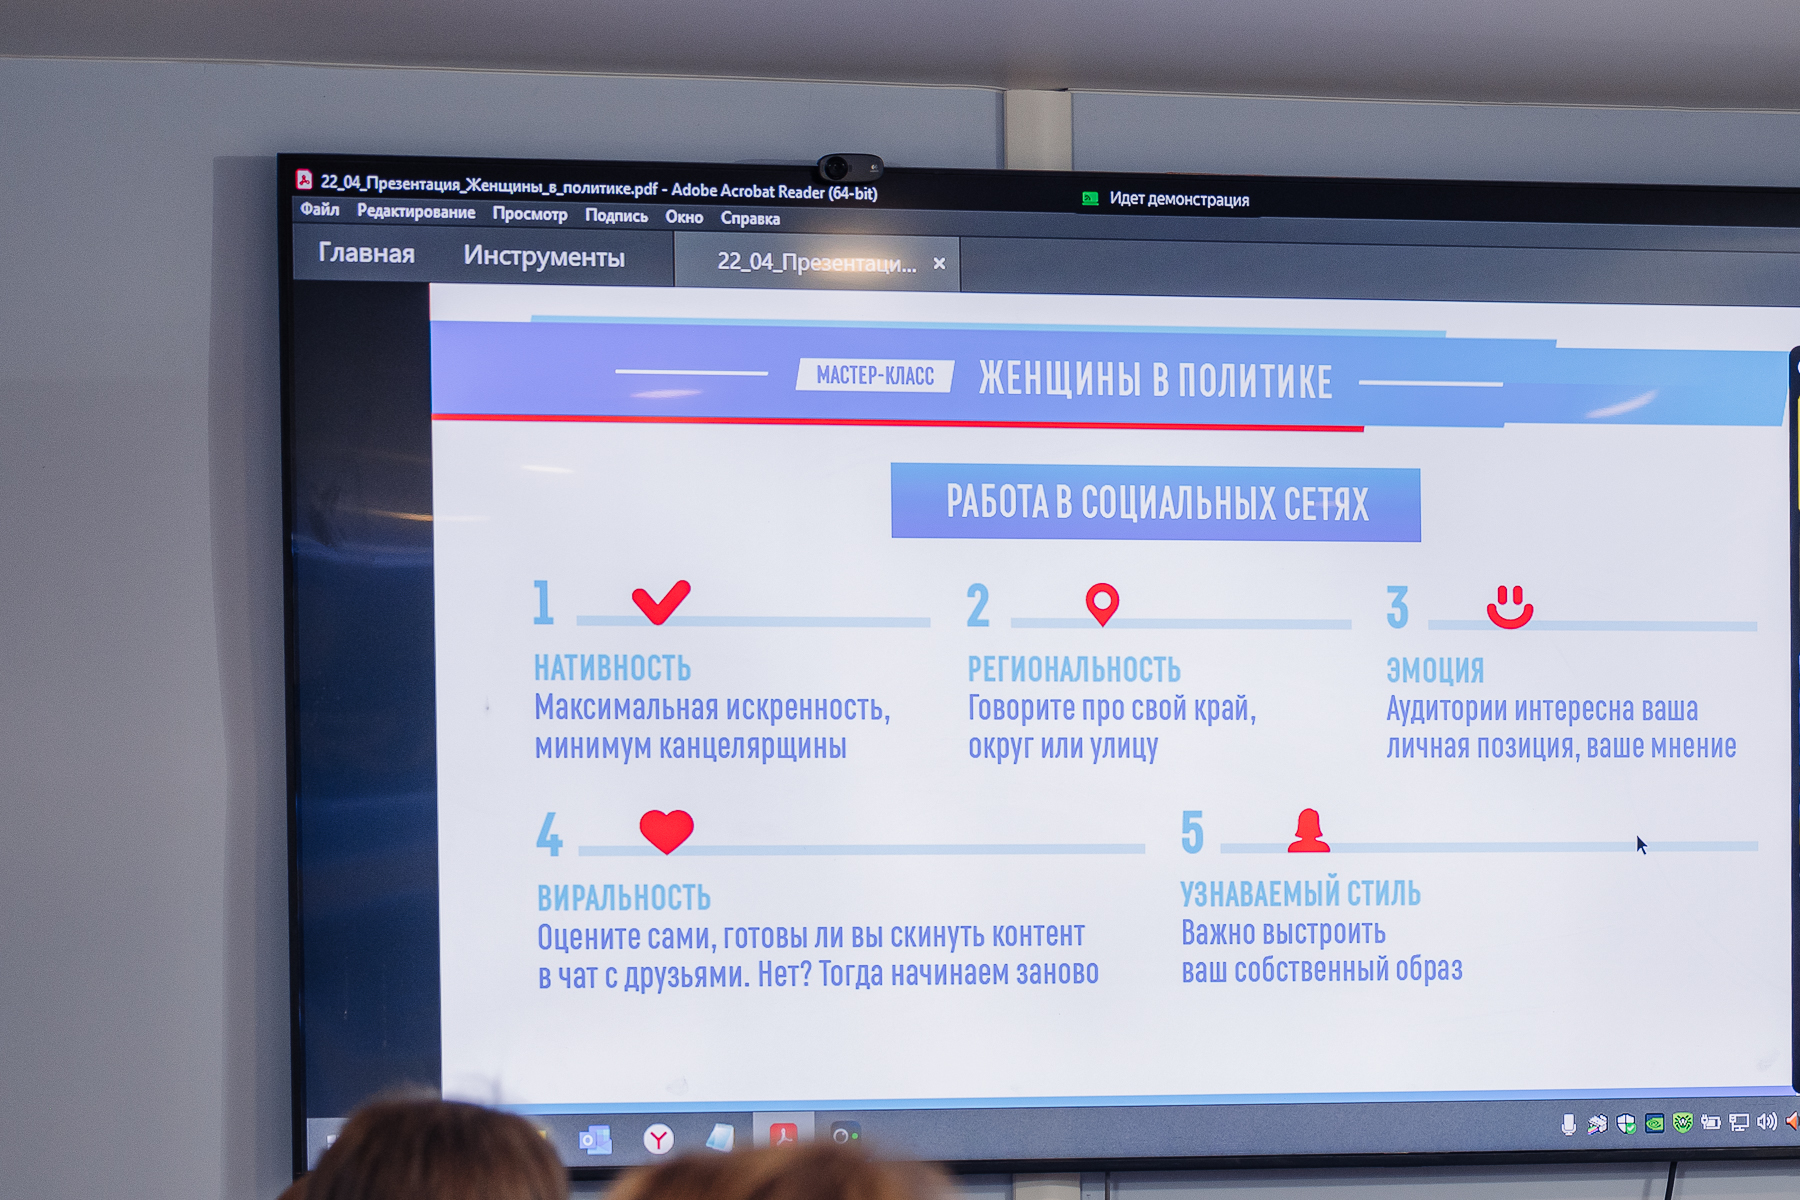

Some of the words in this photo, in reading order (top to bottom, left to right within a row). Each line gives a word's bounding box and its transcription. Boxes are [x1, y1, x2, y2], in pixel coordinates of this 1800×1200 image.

[320, 173, 659, 199] 22_04_Презентация_Женщины_в_политике.pdf
[670, 182, 718, 197] Adobe
[719, 183, 776, 199] Acrobat
[778, 184, 826, 200] Reader
[828, 185, 878, 203] (64-bit)
[1110, 190, 1146, 207] Идет
[1147, 193, 1250, 209] демонстрация
[299, 201, 340, 217] Файл
[357, 202, 476, 222] Редактирование
[492, 205, 569, 225] Просмотр
[585, 207, 649, 225] Подпись
[665, 208, 705, 224] Окно
[720, 210, 781, 229] Справка
[319, 240, 415, 264] Главная
[464, 243, 625, 273] Инструменты
[718, 250, 917, 277] 22_04_Презентаци...
[816, 363, 935, 388] МАСТЕР-КЛАСС
[978, 359, 1141, 400] ЖЕНЩИНЫ
[1153, 362, 1169, 397] В
[1179, 362, 1333, 399] ПОЛИТИКЕ
[947, 482, 1050, 519] РАБОТА
[1056, 483, 1073, 519] В
[1082, 484, 1277, 524] СОЦИАЛЬНЫХ
[1284, 486, 1370, 522] СЕТЯХ
[533, 579, 554, 625] 1
[966, 582, 990, 628] 2
[1386, 585, 1409, 630] 3
[534, 653, 692, 682] НАТИВНОСТЬ
[968, 655, 1181, 683] РЕГИОНАЛЬНОСТЬ
[1386, 656, 1484, 687] ЭМОЦИЯ
[535, 692, 718, 720] Максимальная
[726, 698, 890, 727] искренность,
[969, 693, 1075, 727] Говорите
[1082, 698, 1125, 727] про
[1132, 694, 1186, 721] свой
[1194, 694, 1256, 727] край,
[1386, 694, 1507, 727] Аудитории
[1515, 699, 1634, 727] интересна
[1642, 699, 1698, 721] ваша
[535, 736, 651, 765] минимум
[660, 736, 846, 765] канцелярщины
[969, 736, 1035, 765] округ
[1041, 736, 1083, 759] или
[1089, 736, 1159, 765] улицу
[1386, 736, 1470, 759] личная
[1477, 737, 1581, 763] позиция,
[1587, 737, 1645, 759] ваше
[1651, 737, 1737, 758] мнение
[535, 811, 564, 857] 4
[1181, 810, 1204, 855] 5
[537, 883, 711, 912] ВИРАЛЬНОСТЬ
[1179, 872, 1340, 908] УЗНАВАЕМЫЙ
[1347, 879, 1421, 907] СТИЛЬ
[538, 923, 641, 954] Оцените
[648, 927, 717, 954] сами,
[724, 926, 808, 949] готовы
[814, 926, 844, 948] ли
[852, 925, 883, 948] вы
[891, 925, 985, 954] скинуть
[992, 924, 1086, 947] контент
[1182, 918, 1255, 946] Важно
[1263, 922, 1386, 951] выстроить
[539, 967, 552, 989] в
[558, 966, 599, 989] чат
[605, 966, 618, 989] с
[624, 965, 750, 995] друзьями.
[758, 959, 812, 987] Нет?
[818, 959, 883, 990] Тогда
[891, 963, 1009, 986] начинаем
[1016, 962, 1099, 985] заново
[1182, 961, 1227, 983] ваш
[1234, 954, 1389, 983] собственный
[1396, 953, 1463, 987] образ
